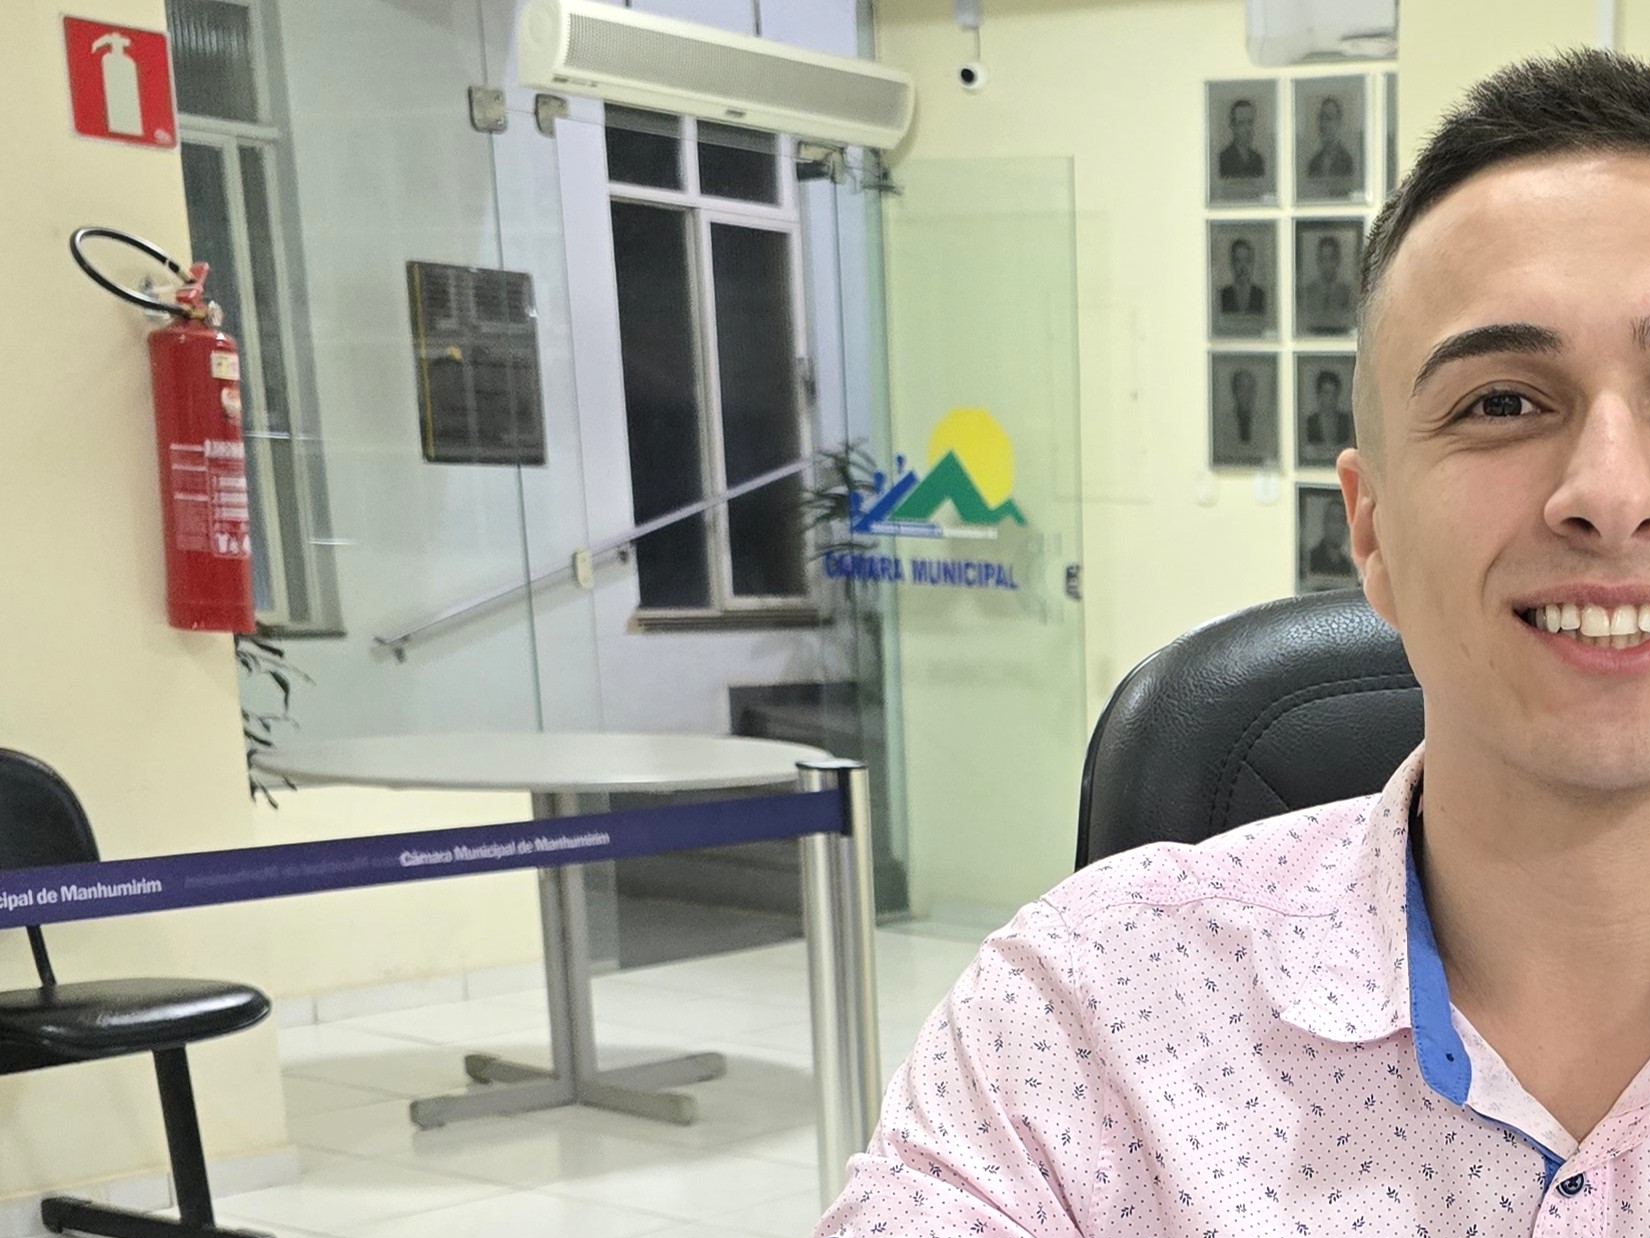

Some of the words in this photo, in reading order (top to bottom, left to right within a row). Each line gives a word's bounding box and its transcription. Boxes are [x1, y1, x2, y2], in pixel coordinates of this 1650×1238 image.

[911, 556, 1018, 590] MUNICIPAL
[453, 841, 516, 861] Municipal
[517, 839, 534, 854] de
[36, 887, 58, 905] de
[61, 877, 163, 902] Manhumirim
